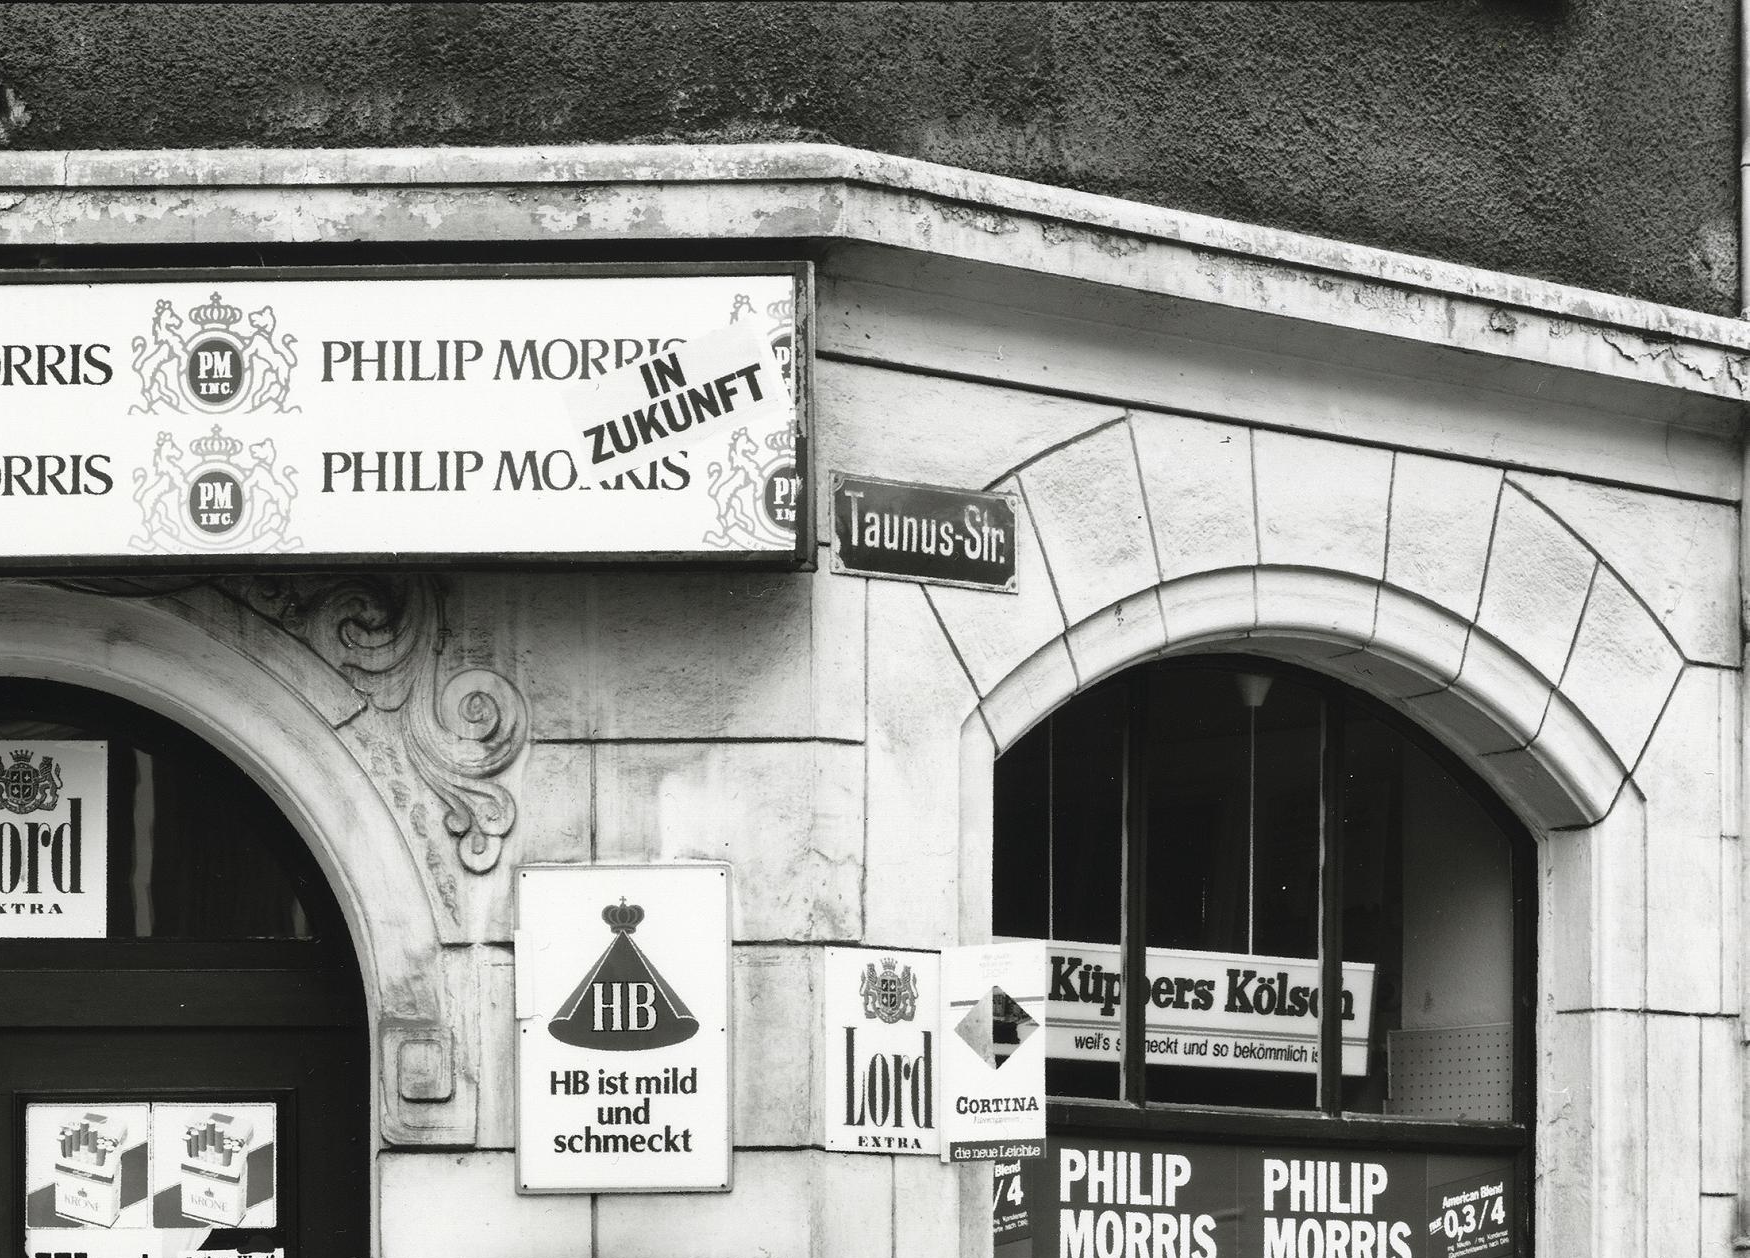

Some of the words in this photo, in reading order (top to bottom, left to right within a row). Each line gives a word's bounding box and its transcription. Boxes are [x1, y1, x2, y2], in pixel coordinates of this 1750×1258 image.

[198, 351, 233, 379] PM
[321, 339, 484, 383] PHILIP
[493, 338, 688, 380] MORR
[200, 382, 233, 396] INC.
[640, 353, 687, 399] IN
[583, 363, 763, 464] ZUKUNFT
[321, 450, 484, 493] PHILIP
[493, 450, 690, 490] MOIS
[198, 482, 233, 510] PM
[200, 513, 234, 525] INC.
[845, 489, 1006, 564] Taunus-Str.
[592, 982, 659, 1032] HB
[1074, 1032, 1110, 1051] weil's
[1115, 1036, 1178, 1055] smeckt
[1184, 1039, 1208, 1056] und
[1213, 1042, 1229, 1057] so
[1234, 1041, 1308, 1063] bekömmlich
[550, 1071, 590, 1096] HB
[598, 1069, 629, 1095] ist
[634, 1067, 698, 1095] mild
[843, 1026, 936, 1130] Lord
[597, 1098, 650, 1125] und
[956, 1096, 1040, 1116] CORTINA
[553, 1125, 693, 1153] schmeckt
[857, 1136, 923, 1150] EXTRA
[954, 1146, 971, 1160] die
[972, 1148, 997, 1160] neue
[999, 1145, 1041, 1160] Leichte
[994, 1159, 1022, 1178] Blend
[1059, 1148, 1192, 1207] PHILIP
[1263, 1159, 1388, 1215] PHILIP
[1442, 1191, 1479, 1209] American
[1480, 1181, 1503, 1199] Blend
